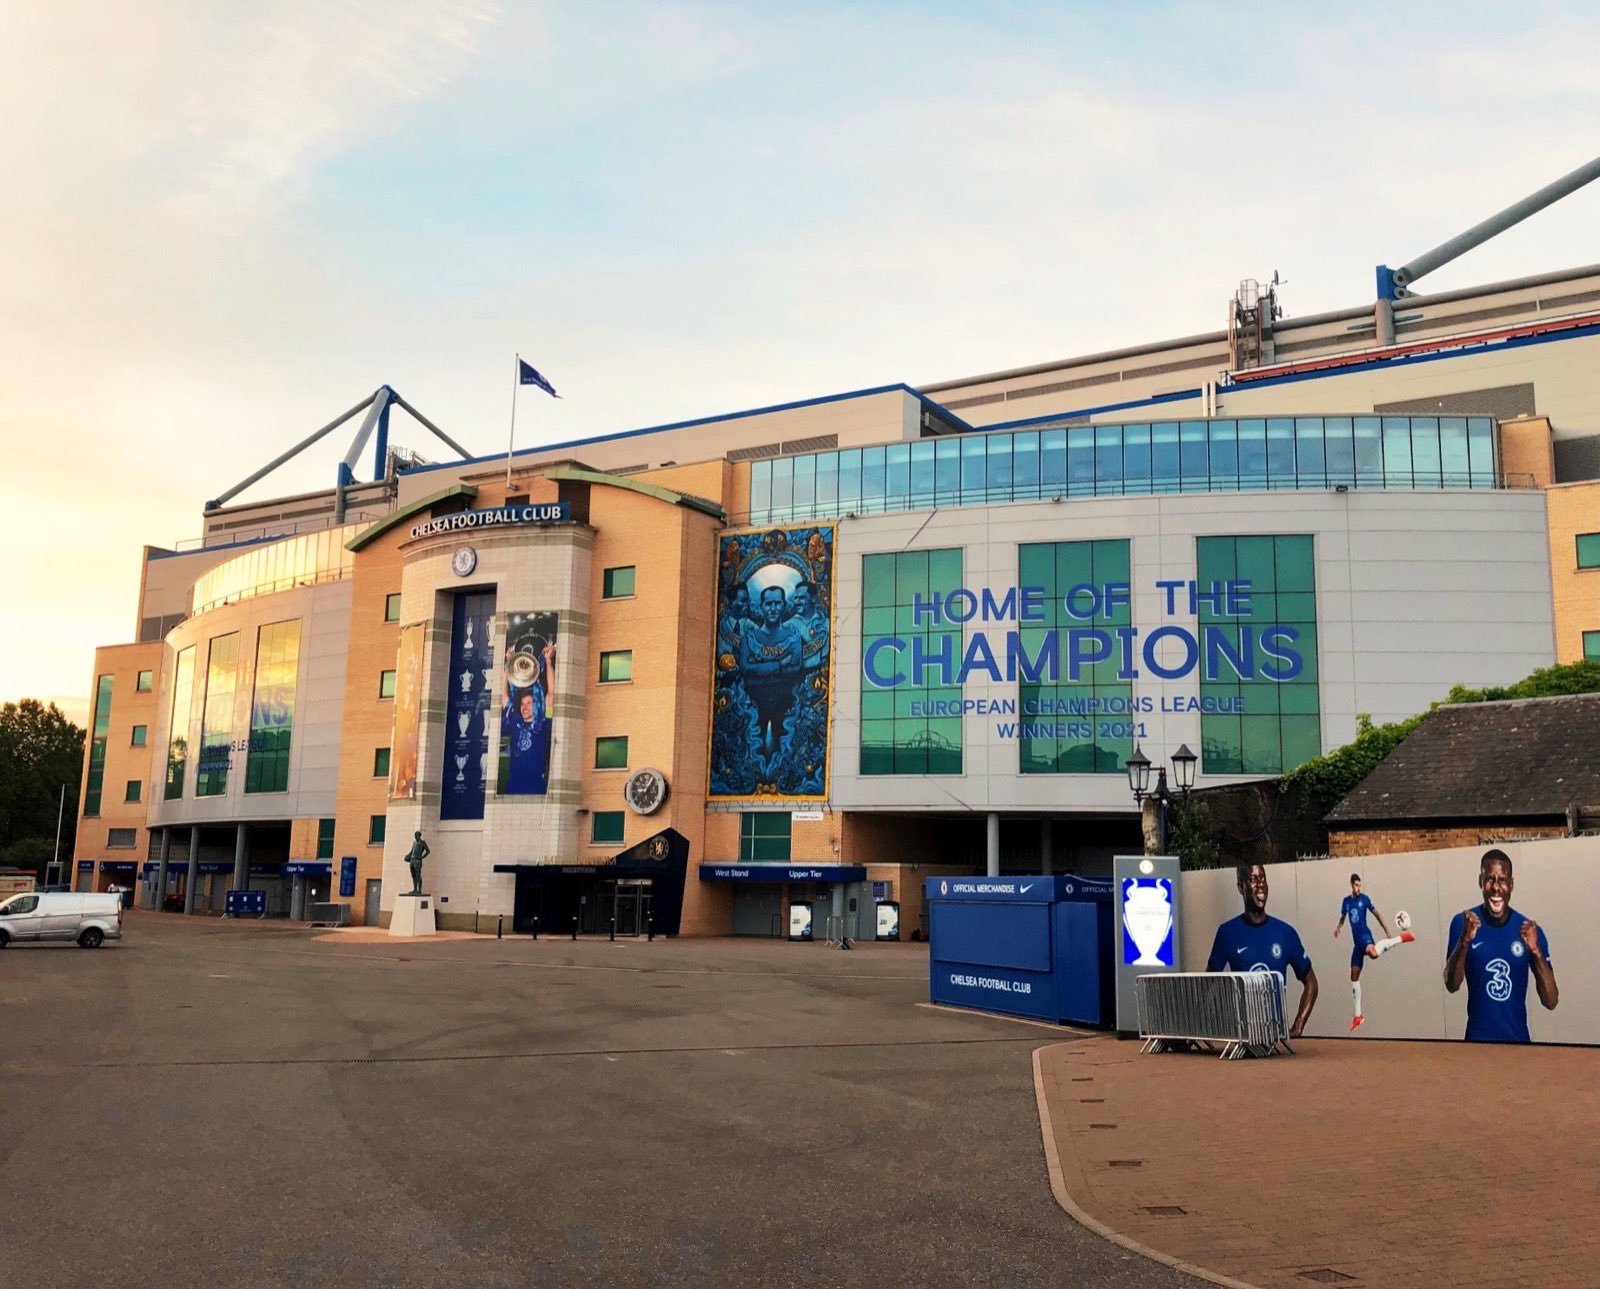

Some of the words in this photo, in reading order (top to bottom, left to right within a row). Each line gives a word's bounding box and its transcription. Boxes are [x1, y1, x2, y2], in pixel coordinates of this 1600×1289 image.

[410, 517, 451, 539] CHELSEA
[452, 508, 519, 529] FOOTBALL
[522, 505, 561, 521] CLUB
[911, 585, 1046, 627] HOME
[1063, 581, 1130, 620] OF
[1155, 578, 1253, 618] THE
[862, 624, 1305, 689] CHAMPIONS
[910, 698, 1016, 718] EUROPEAN
[1023, 696, 1154, 716] CHAMPIONS
[1160, 695, 1246, 715] LEAGUE
[996, 721, 1093, 740] WINNERS
[1098, 721, 1148, 739] 2021
[715, 869, 730, 877] West
[730, 869, 749, 877] Stand
[788, 870, 809, 879] Upper
[809, 869, 823, 878] Tier
[953, 883, 976, 893] OFFICIAL
[976, 884, 1015, 894] MERCHANDISE
[950, 974, 978, 987] CHELSEA
[978, 976, 1011, 992] FOOTBALL
[1012, 982, 1032, 994] CLUB
[1485, 957, 1513, 1002] 3
